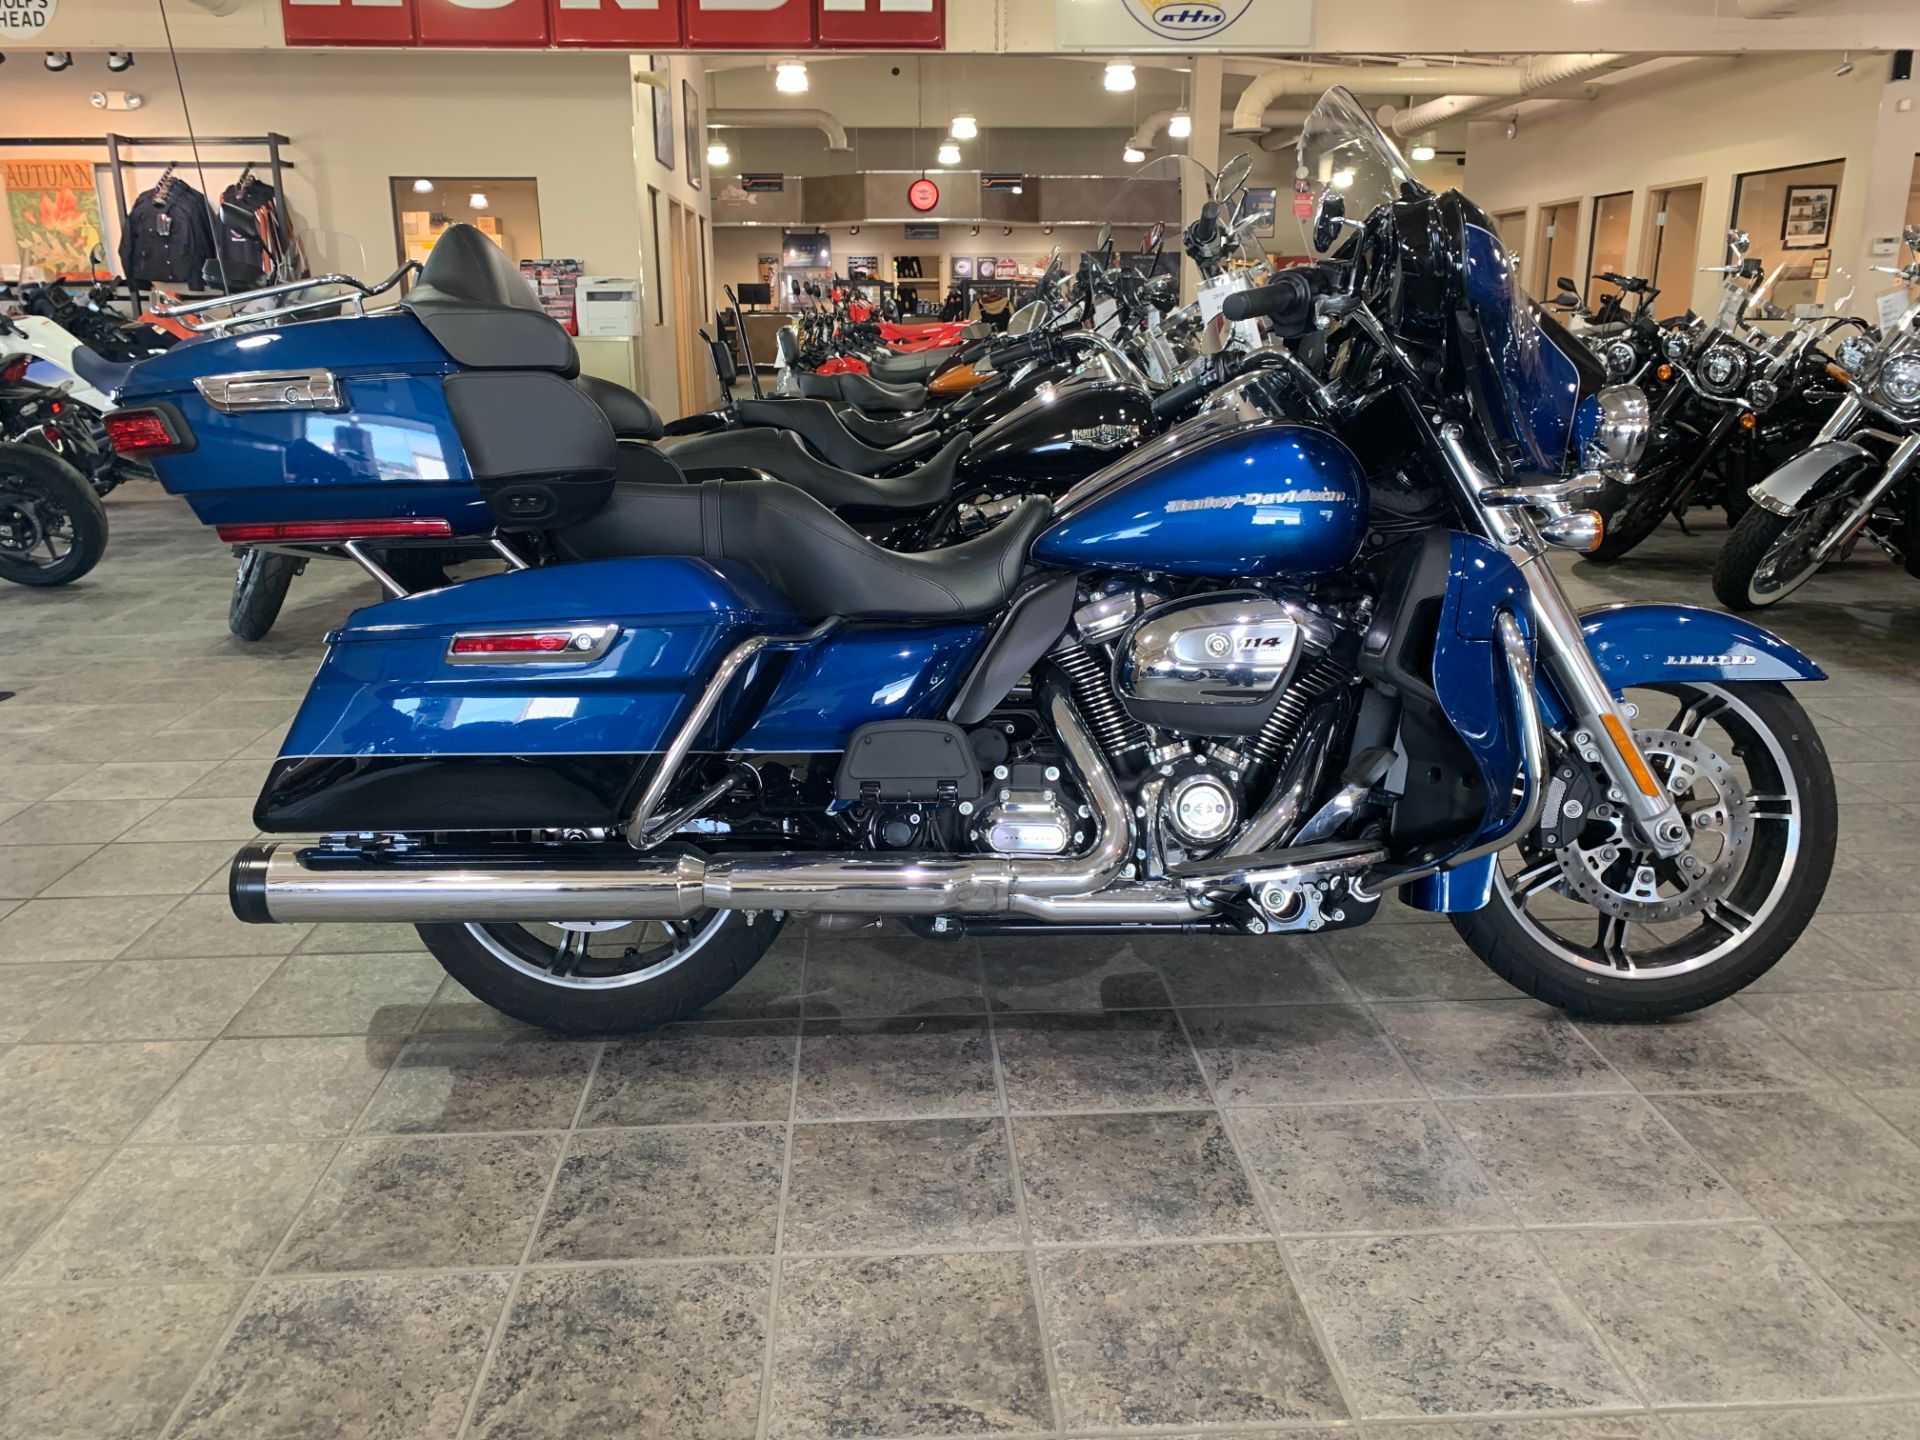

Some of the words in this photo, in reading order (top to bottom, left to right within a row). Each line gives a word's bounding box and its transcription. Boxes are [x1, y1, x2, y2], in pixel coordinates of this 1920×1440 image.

[0, 10, 46, 27] HEAD
[6, 163, 92, 187] AUTUMN
[1243, 637, 1282, 648] 114
[1663, 655, 1757, 665] LIMITED
